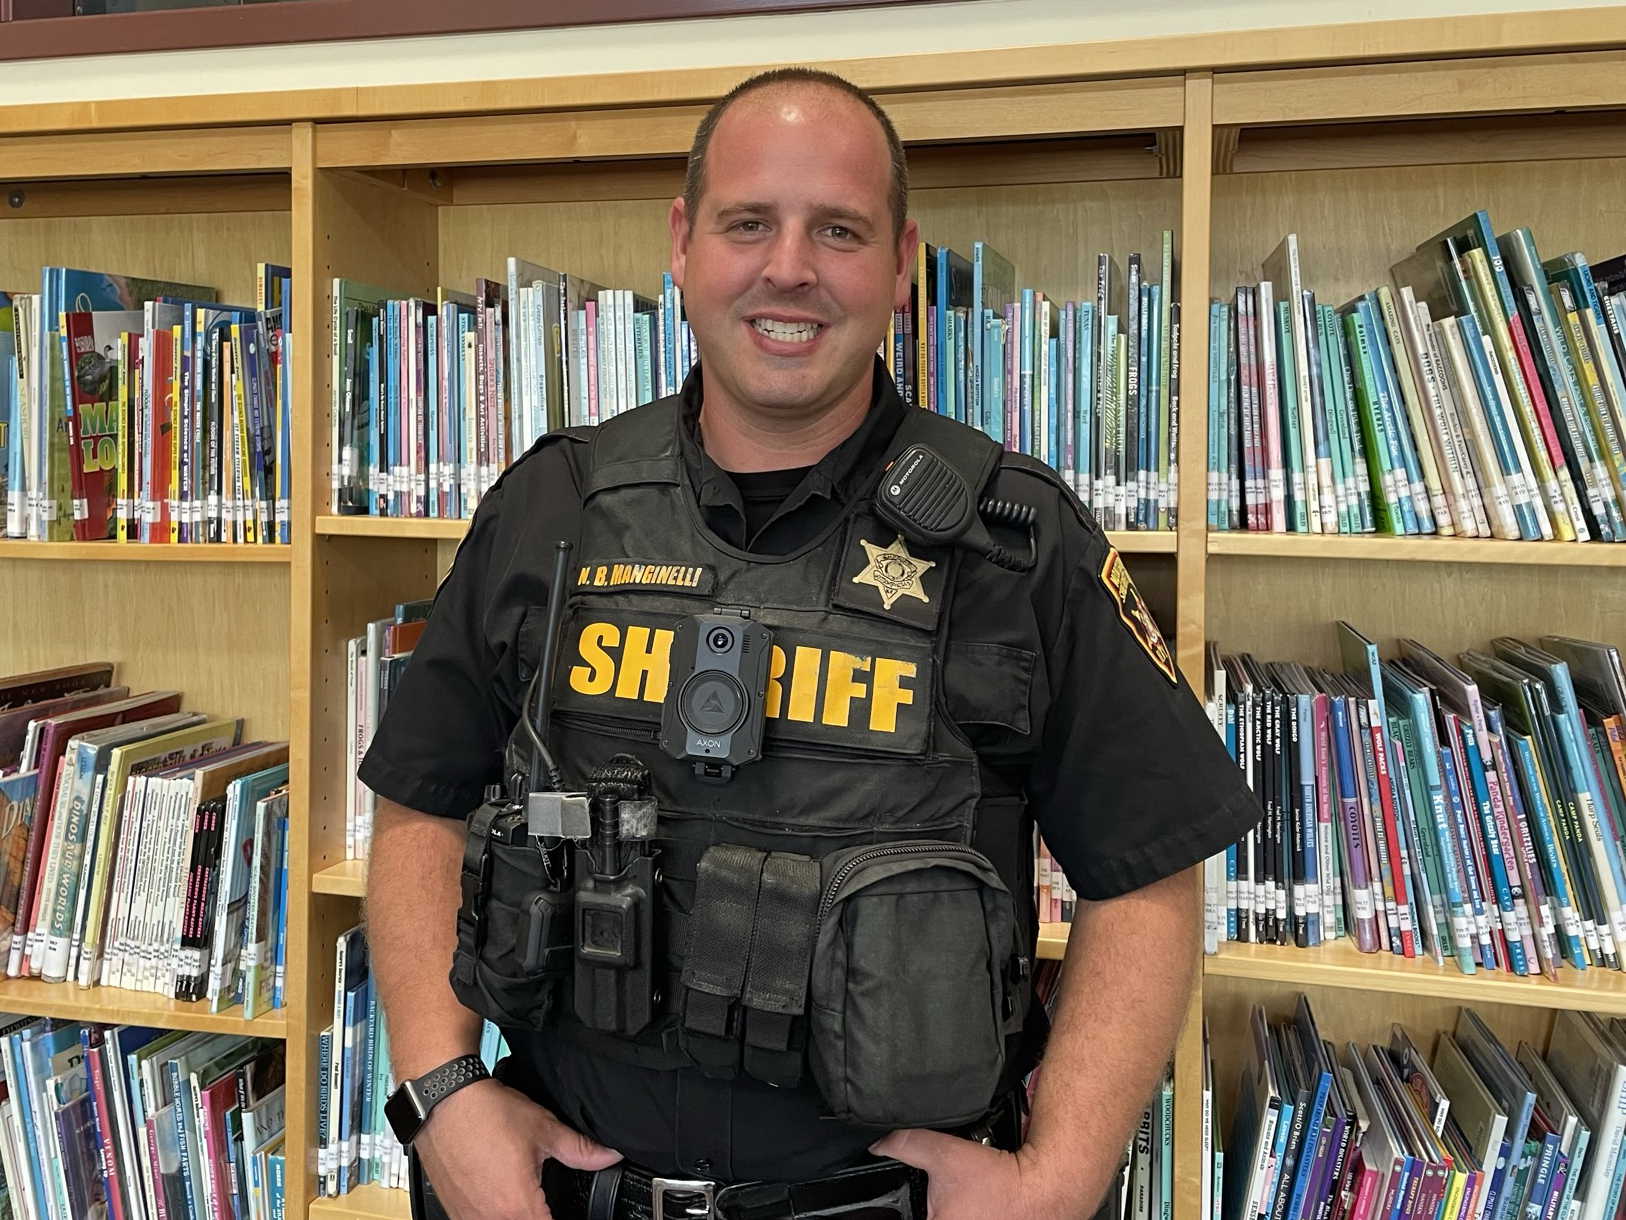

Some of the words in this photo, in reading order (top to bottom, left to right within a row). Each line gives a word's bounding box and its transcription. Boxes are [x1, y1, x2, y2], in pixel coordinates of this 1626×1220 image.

[1492, 255, 1504, 272] 100
[1583, 270, 1593, 287] LIONS
[1588, 289, 1597, 300] AND
[1591, 301, 1602, 320] TIGERS
[1603, 296, 1620, 334] CHEETAHS
[1327, 310, 1335, 337] COYOTE
[1385, 302, 1396, 327] AMAZING
[1393, 331, 1401, 344] CATS
[1171, 324, 1179, 348] Tadpole
[895, 342, 904, 374] WEIRD
[1489, 351, 1500, 375] RACCOONS
[1555, 325, 1568, 353] WILD
[1563, 356, 1578, 381] CATS
[1421, 353, 1436, 384] DOGS
[1435, 358, 1448, 391] RACCOONS
[1128, 367, 1137, 395] FROGS
[1380, 391, 1390, 411] The
[1372, 401, 1384, 433] HYENAS
[1383, 413, 1394, 436] Arctic
[1391, 438, 1400, 456] Fox
[1530, 428, 1545, 453] LION
[183, 453, 189, 463] of
[899, 454, 924, 485] MOTOROLA
[578, 567, 590, 586] N.
[593, 566, 608, 586] B.
[610, 564, 702, 587] MANGINELLI
[569, 623, 917, 732] SHIFF
[696, 739, 721, 749] AXON
[1375, 733, 1383, 752] WOLF
[1403, 725, 1413, 748] GRIZZLY
[1466, 729, 1475, 746] Potts
[1378, 754, 1386, 775] PACKS
[1407, 750, 1416, 769] BEARS
[59, 769, 72, 809] DINOSAURS
[1489, 780, 1503, 808] Panda
[1305, 803, 1313, 827] AMERICAN
[1432, 795, 1448, 830] Knut
[1481, 801, 1492, 814] The
[1556, 799, 1565, 819] CAMP
[55, 822, 63, 840] HOW
[1348, 806, 1360, 848] COYOTES
[1483, 815, 1496, 837] Grizzly
[1560, 819, 1570, 841] PANDA
[1568, 802, 1577, 821] CAMP
[1573, 822, 1583, 843] PANDA
[1586, 798, 1596, 818] Harp
[1591, 820, 1603, 842] Seals
[63, 800, 82, 868] DINOSAUR
[1306, 828, 1314, 847] WOLVES
[1421, 828, 1430, 858] Greenland
[1494, 811, 1516, 871] Kindergarten
[1519, 821, 1536, 864] GRIZZLIES
[52, 842, 61, 860] THEY
[1490, 840, 1500, 855] Bear
[1547, 844, 1557, 868] Bears
[48, 862, 58, 883] LIVED
[54, 873, 73, 929] WORLDS
[320, 1035, 329, 1068] WHERE
[366, 1038, 374, 1060] BIRDS
[320, 1071, 328, 1084] DO
[366, 1062, 373, 1071] OF
[172, 1072, 180, 1097] BUBBLE
[365, 1072, 373, 1102] WINTER
[174, 1098, 183, 1121] HOMES
[319, 1086, 327, 1111] BIRDS
[319, 1114, 327, 1139] LIVE?
[1340, 1126, 1349, 1147] WORLD
[178, 1134, 186, 1150] FISH
[103, 1138, 114, 1175] VENOM
[181, 1152, 189, 1176] FARTS
[1332, 1148, 1346, 1180] DISASTERS
[1537, 1144, 1554, 1184] PRINGLE
[1281, 1174, 1290, 1189] ALL
[1570, 1168, 1578, 1179] THE
[1614, 1174, 1623, 1183] THE
[1409, 1177, 1419, 1199] THERAPY
[1566, 1180, 1576, 1194] STORY
[1610, 1184, 1620, 1198] STORY
[1386, 1189, 1395, 1210] MURRAY
[1405, 1200, 1414, 1214] DOGS
[1416, 1193, 1427, 1215] HANSEN
[1428, 1193, 1438, 1215] HANSEN
[1450, 1187, 1460, 1216] ENGINEERING
[1459, 1188, 1471, 1217] ENGINEERING
[1468, 1186, 1479, 1215] ENGINEERING
[1485, 1191, 1496, 1210] CLIMATE
[1546, 1191, 1559, 1219] MILITARY
[1562, 1202, 1570, 1211] THE
